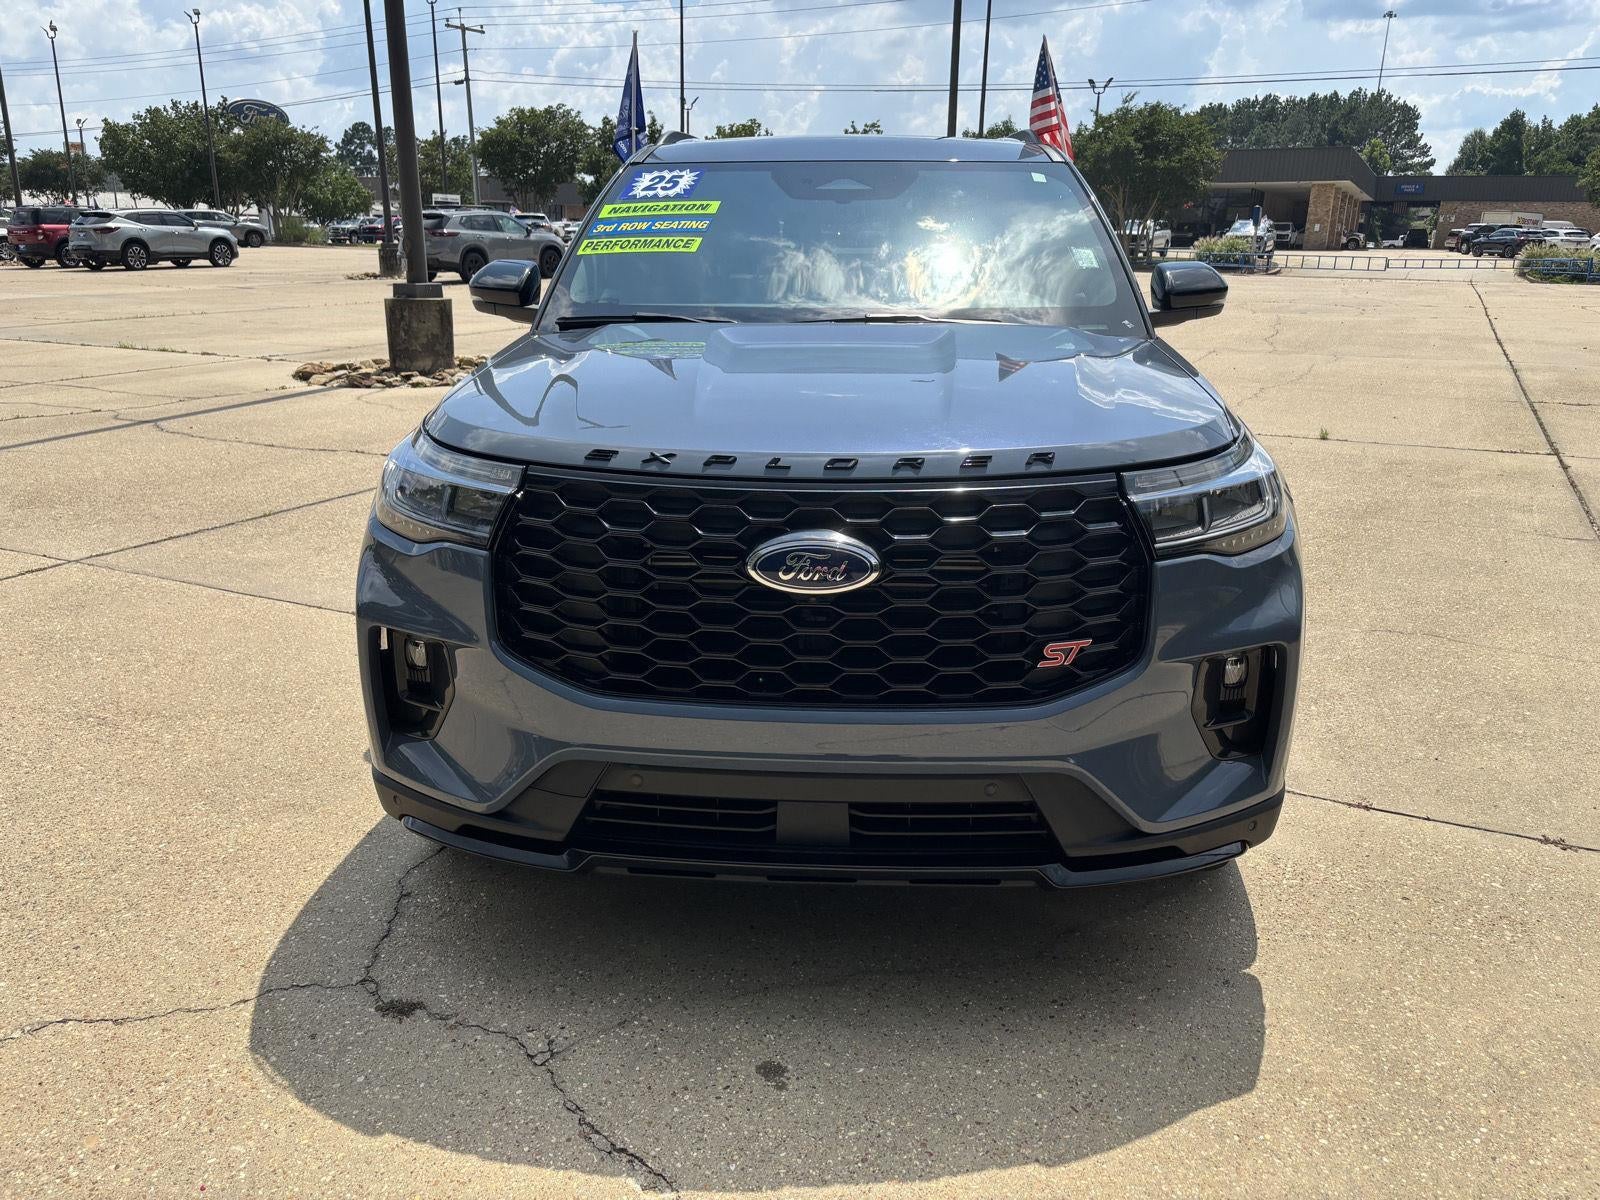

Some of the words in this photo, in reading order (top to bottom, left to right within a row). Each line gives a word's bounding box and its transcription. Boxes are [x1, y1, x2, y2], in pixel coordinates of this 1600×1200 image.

[640, 175, 684, 192] 25
[609, 203, 711, 214] NAVIGATION
[593, 224, 616, 233] 3rd
[618, 221, 649, 231] ROW
[652, 220, 709, 230] SEATING
[581, 239, 696, 252] PERFORMANCE
[584, 448, 1056, 472] EXPLORER
[778, 551, 848, 581] Ford
[1037, 639, 1092, 668] ST
